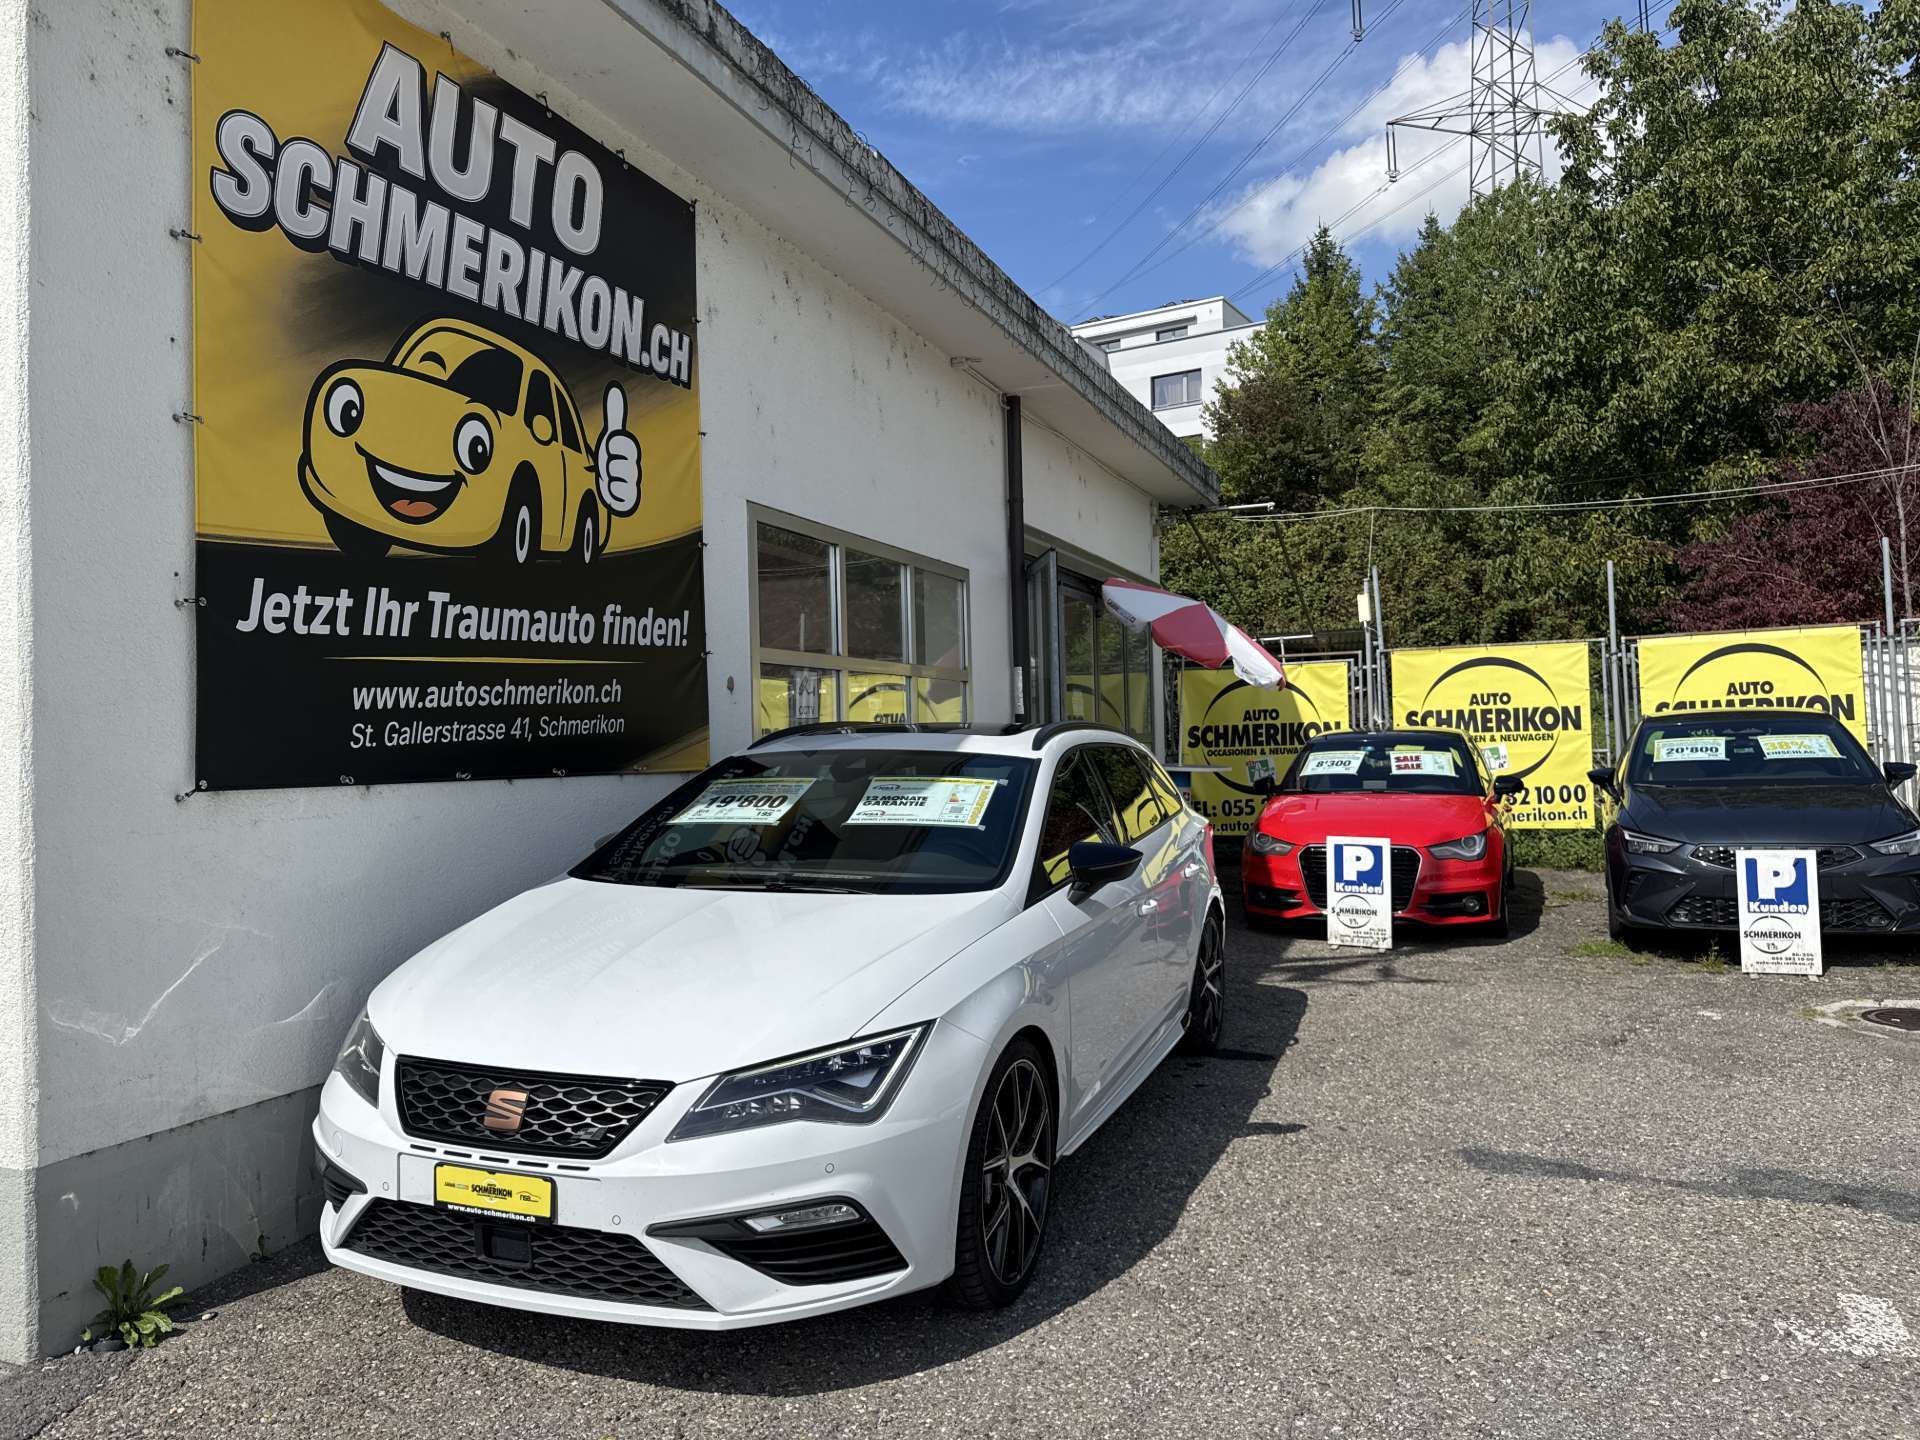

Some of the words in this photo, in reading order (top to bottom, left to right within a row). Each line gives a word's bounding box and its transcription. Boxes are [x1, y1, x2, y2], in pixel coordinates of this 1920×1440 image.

[347, 40, 604, 256] AUTO
[211, 109, 692, 386] SCHMERIKON.CH
[236, 577, 354, 635] Jetzt
[362, 586, 420, 637] Ihr
[427, 591, 595, 644] Traumauto
[602, 604, 690, 647] finden!
[353, 679, 622, 710] www.autoschmerikon.ch
[1726, 681, 1774, 696] AUTO
[1469, 692, 1511, 706] AUTO
[1242, 708, 1280, 723] AUTO
[1405, 706, 1582, 733] SCHMERIKON
[350, 722, 377, 749] St.
[384, 718, 506, 747] Gallerstrasse
[510, 717, 532, 741] 41,
[538, 715, 625, 738] Schmerikon
[1500, 733, 1554, 744] NEUWAGEN
[1206, 748, 1257, 758] OCCASIONEN
[1269, 747, 1299, 756] NEUWA
[1316, 759, 1352, 768] 8'300
[1394, 755, 1422, 763] SALE
[704, 794, 789, 809] 19'800
[1222, 799, 1255, 818] 055
[1335, 880, 1383, 894] Kunden
[1748, 898, 1808, 914] Kunden
[1743, 930, 1801, 939] SCHMERIKON
[471, 1184, 513, 1198] SCHMERIKON
[447, 1204, 536, 1223] www.auto-schmerikon.ch
